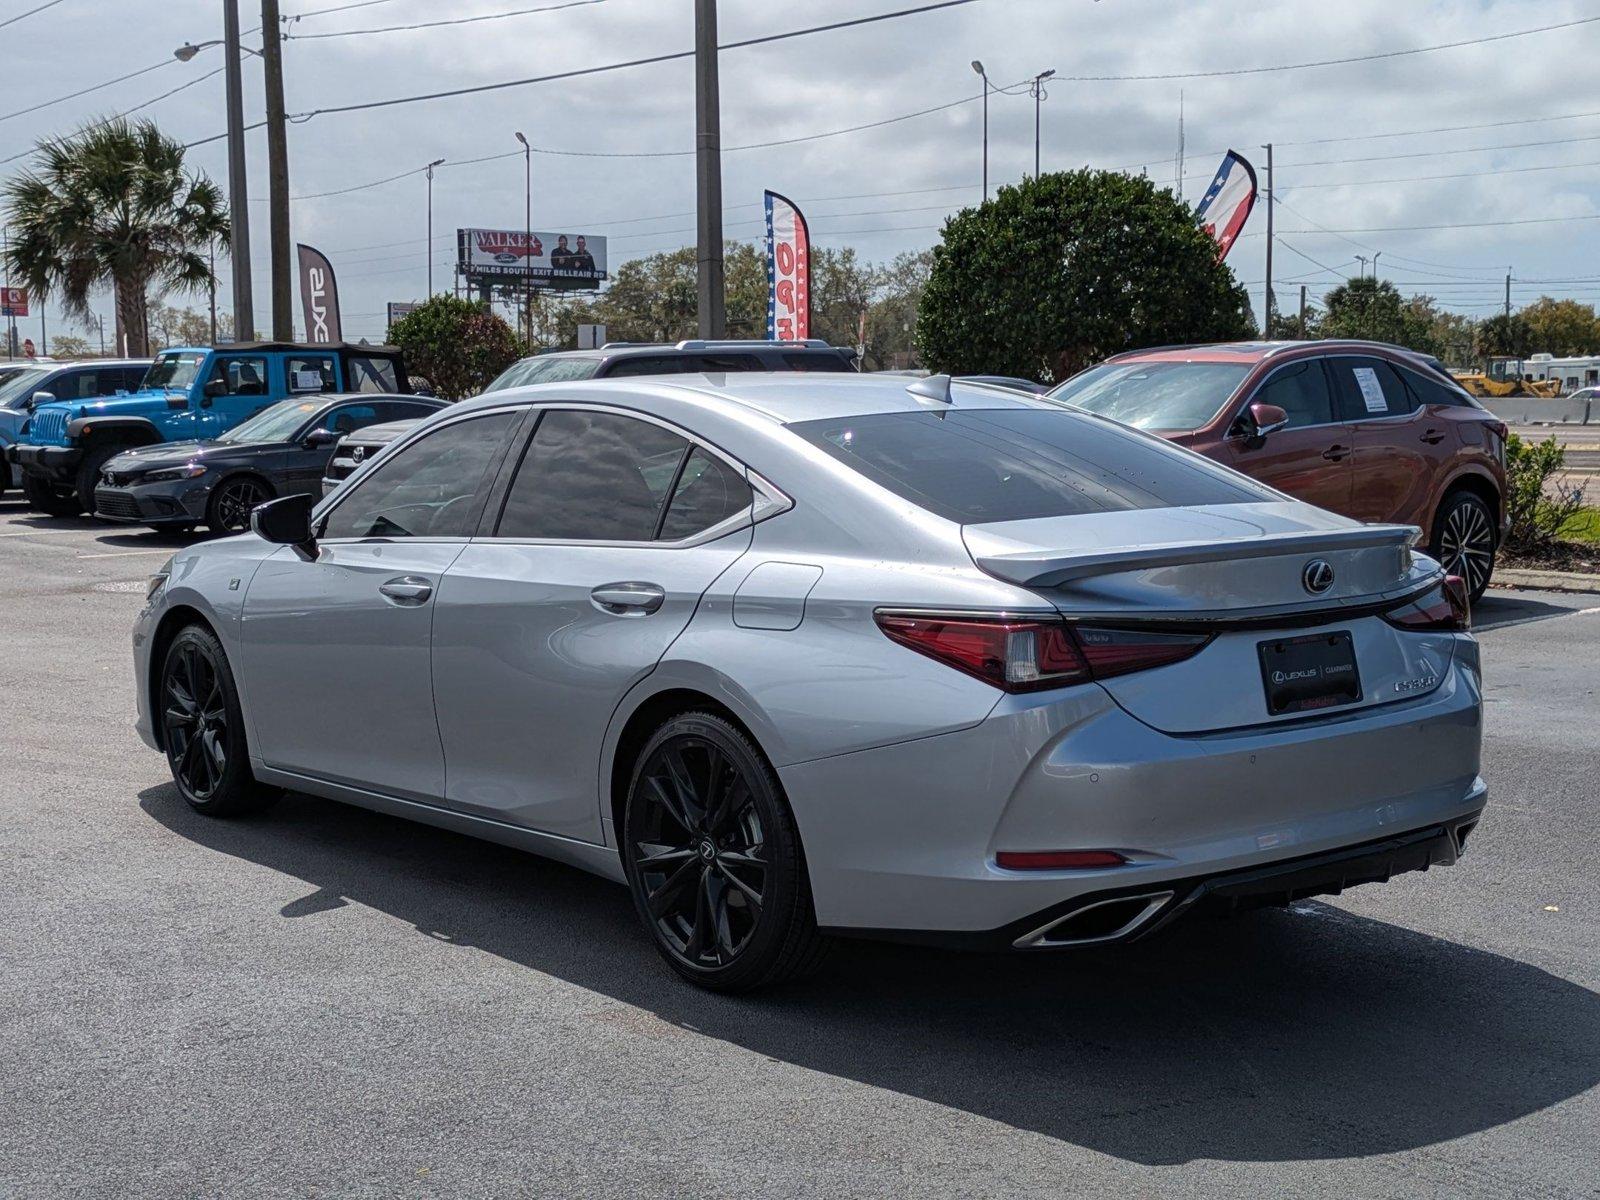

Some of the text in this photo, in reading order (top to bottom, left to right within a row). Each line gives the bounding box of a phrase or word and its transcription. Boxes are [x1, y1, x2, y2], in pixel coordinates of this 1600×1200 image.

[473, 231, 537, 248] WALKER
[476, 266, 501, 274] MILES
[532, 268, 552, 276] EXIT
[553, 269, 592, 278] BELLEAIR
[593, 271, 605, 279] RD
[1284, 669, 1317, 680] LEXUS
